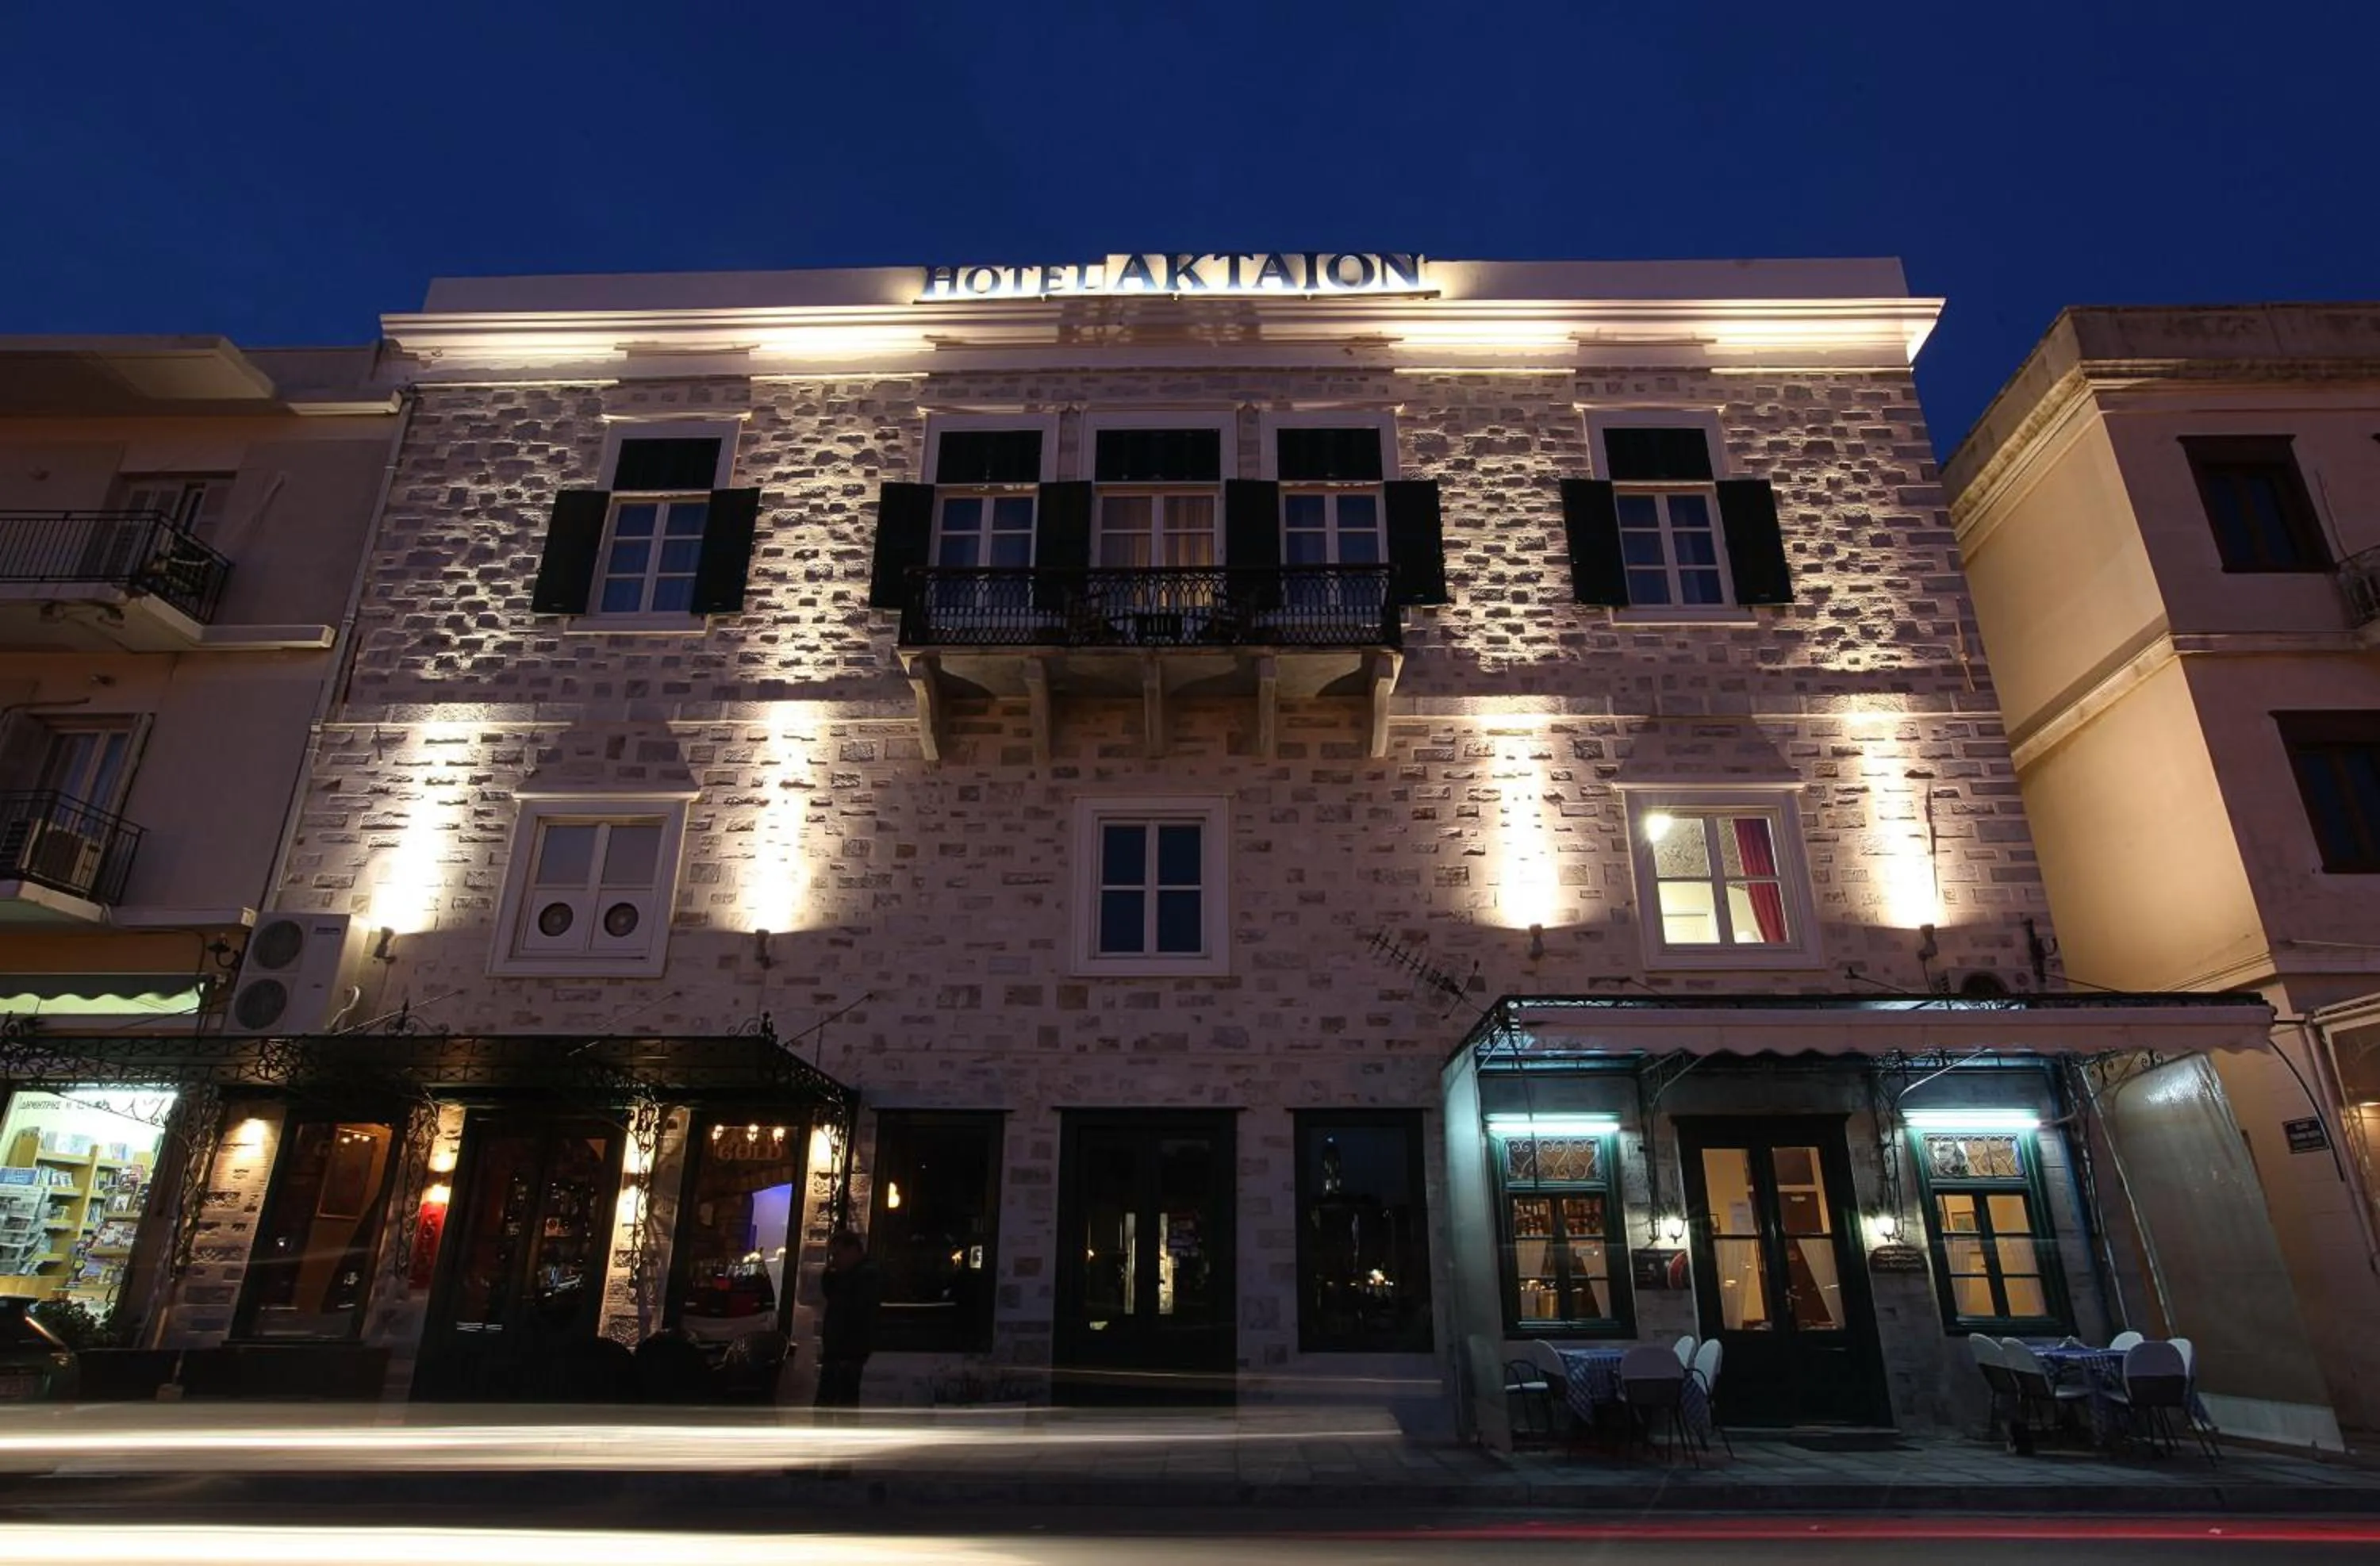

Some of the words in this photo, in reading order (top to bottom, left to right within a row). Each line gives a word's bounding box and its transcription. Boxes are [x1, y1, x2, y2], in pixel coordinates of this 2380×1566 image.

[923, 264, 1102, 296] HOTEL
[1115, 252, 1426, 290] AKTAION
[716, 1143, 784, 1161] GOLD
